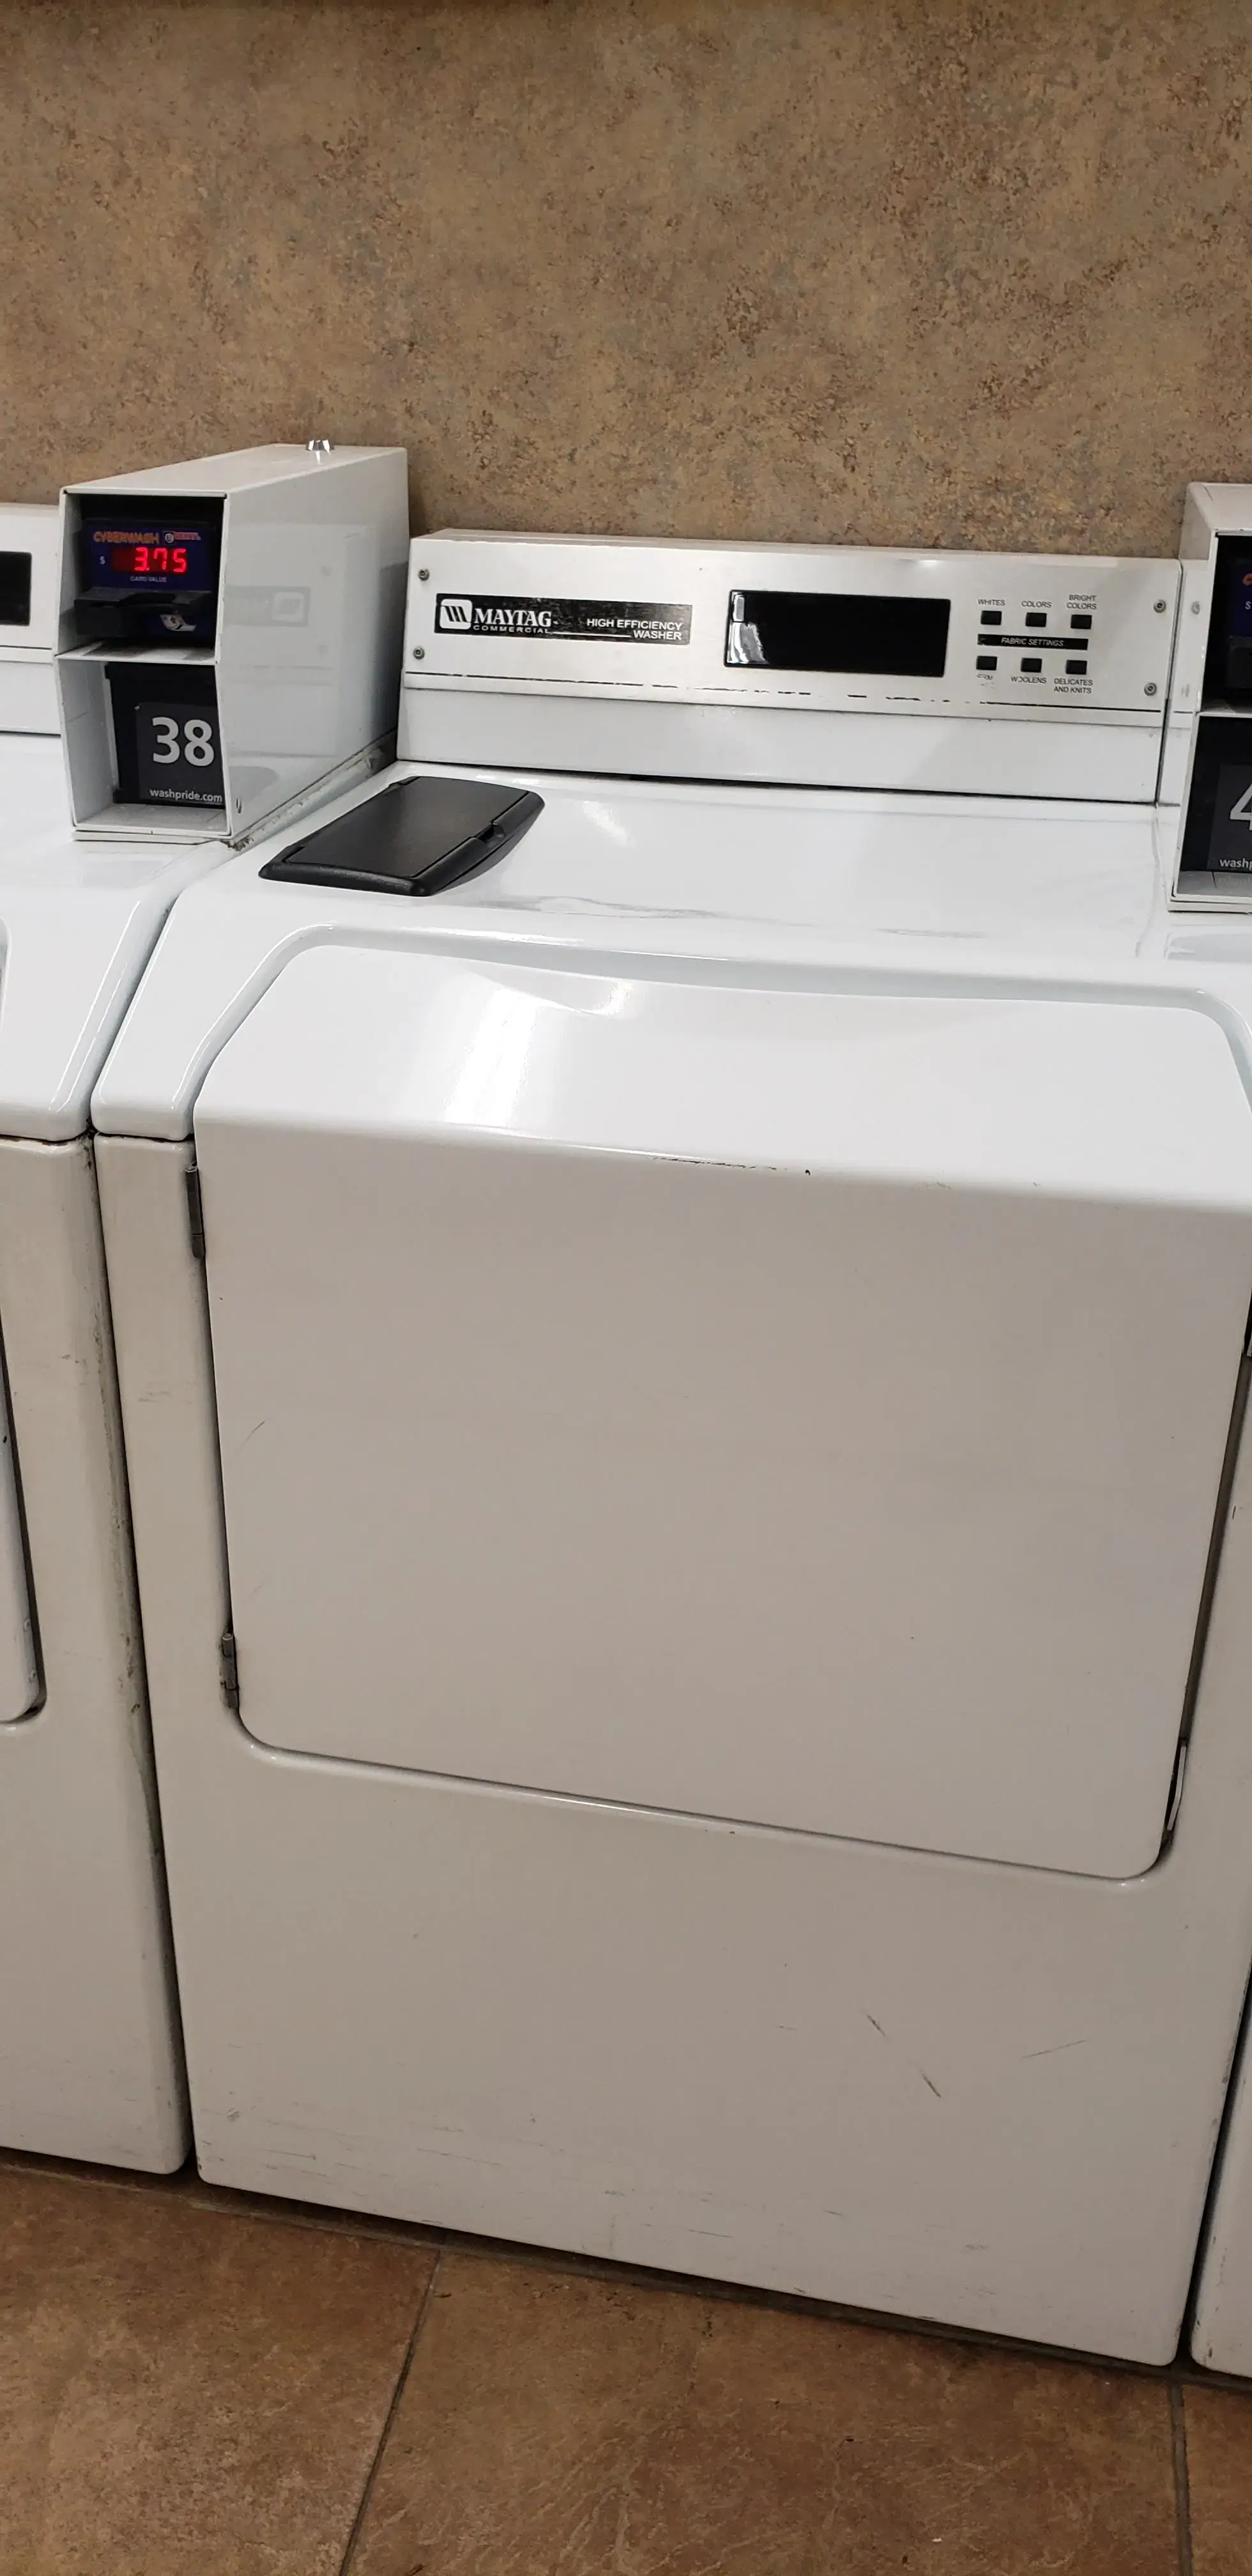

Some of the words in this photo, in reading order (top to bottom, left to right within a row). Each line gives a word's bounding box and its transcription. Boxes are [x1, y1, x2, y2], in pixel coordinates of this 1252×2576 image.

[134, 547, 187, 572] 3.75
[474, 608, 552, 627] MAYTAG
[473, 625, 551, 634] COMMERCIAL
[586, 618, 615, 628] HIGH
[616, 619, 683, 631] EFFICIENCY
[633, 629, 682, 640] WASHER
[1001, 637, 1027, 645] FABRIC
[1028, 638, 1064, 647] SETTINGS
[1054, 678, 1093, 686] DELICATES
[152, 717, 215, 767] 38
[149, 789, 222, 802] washpride.com
